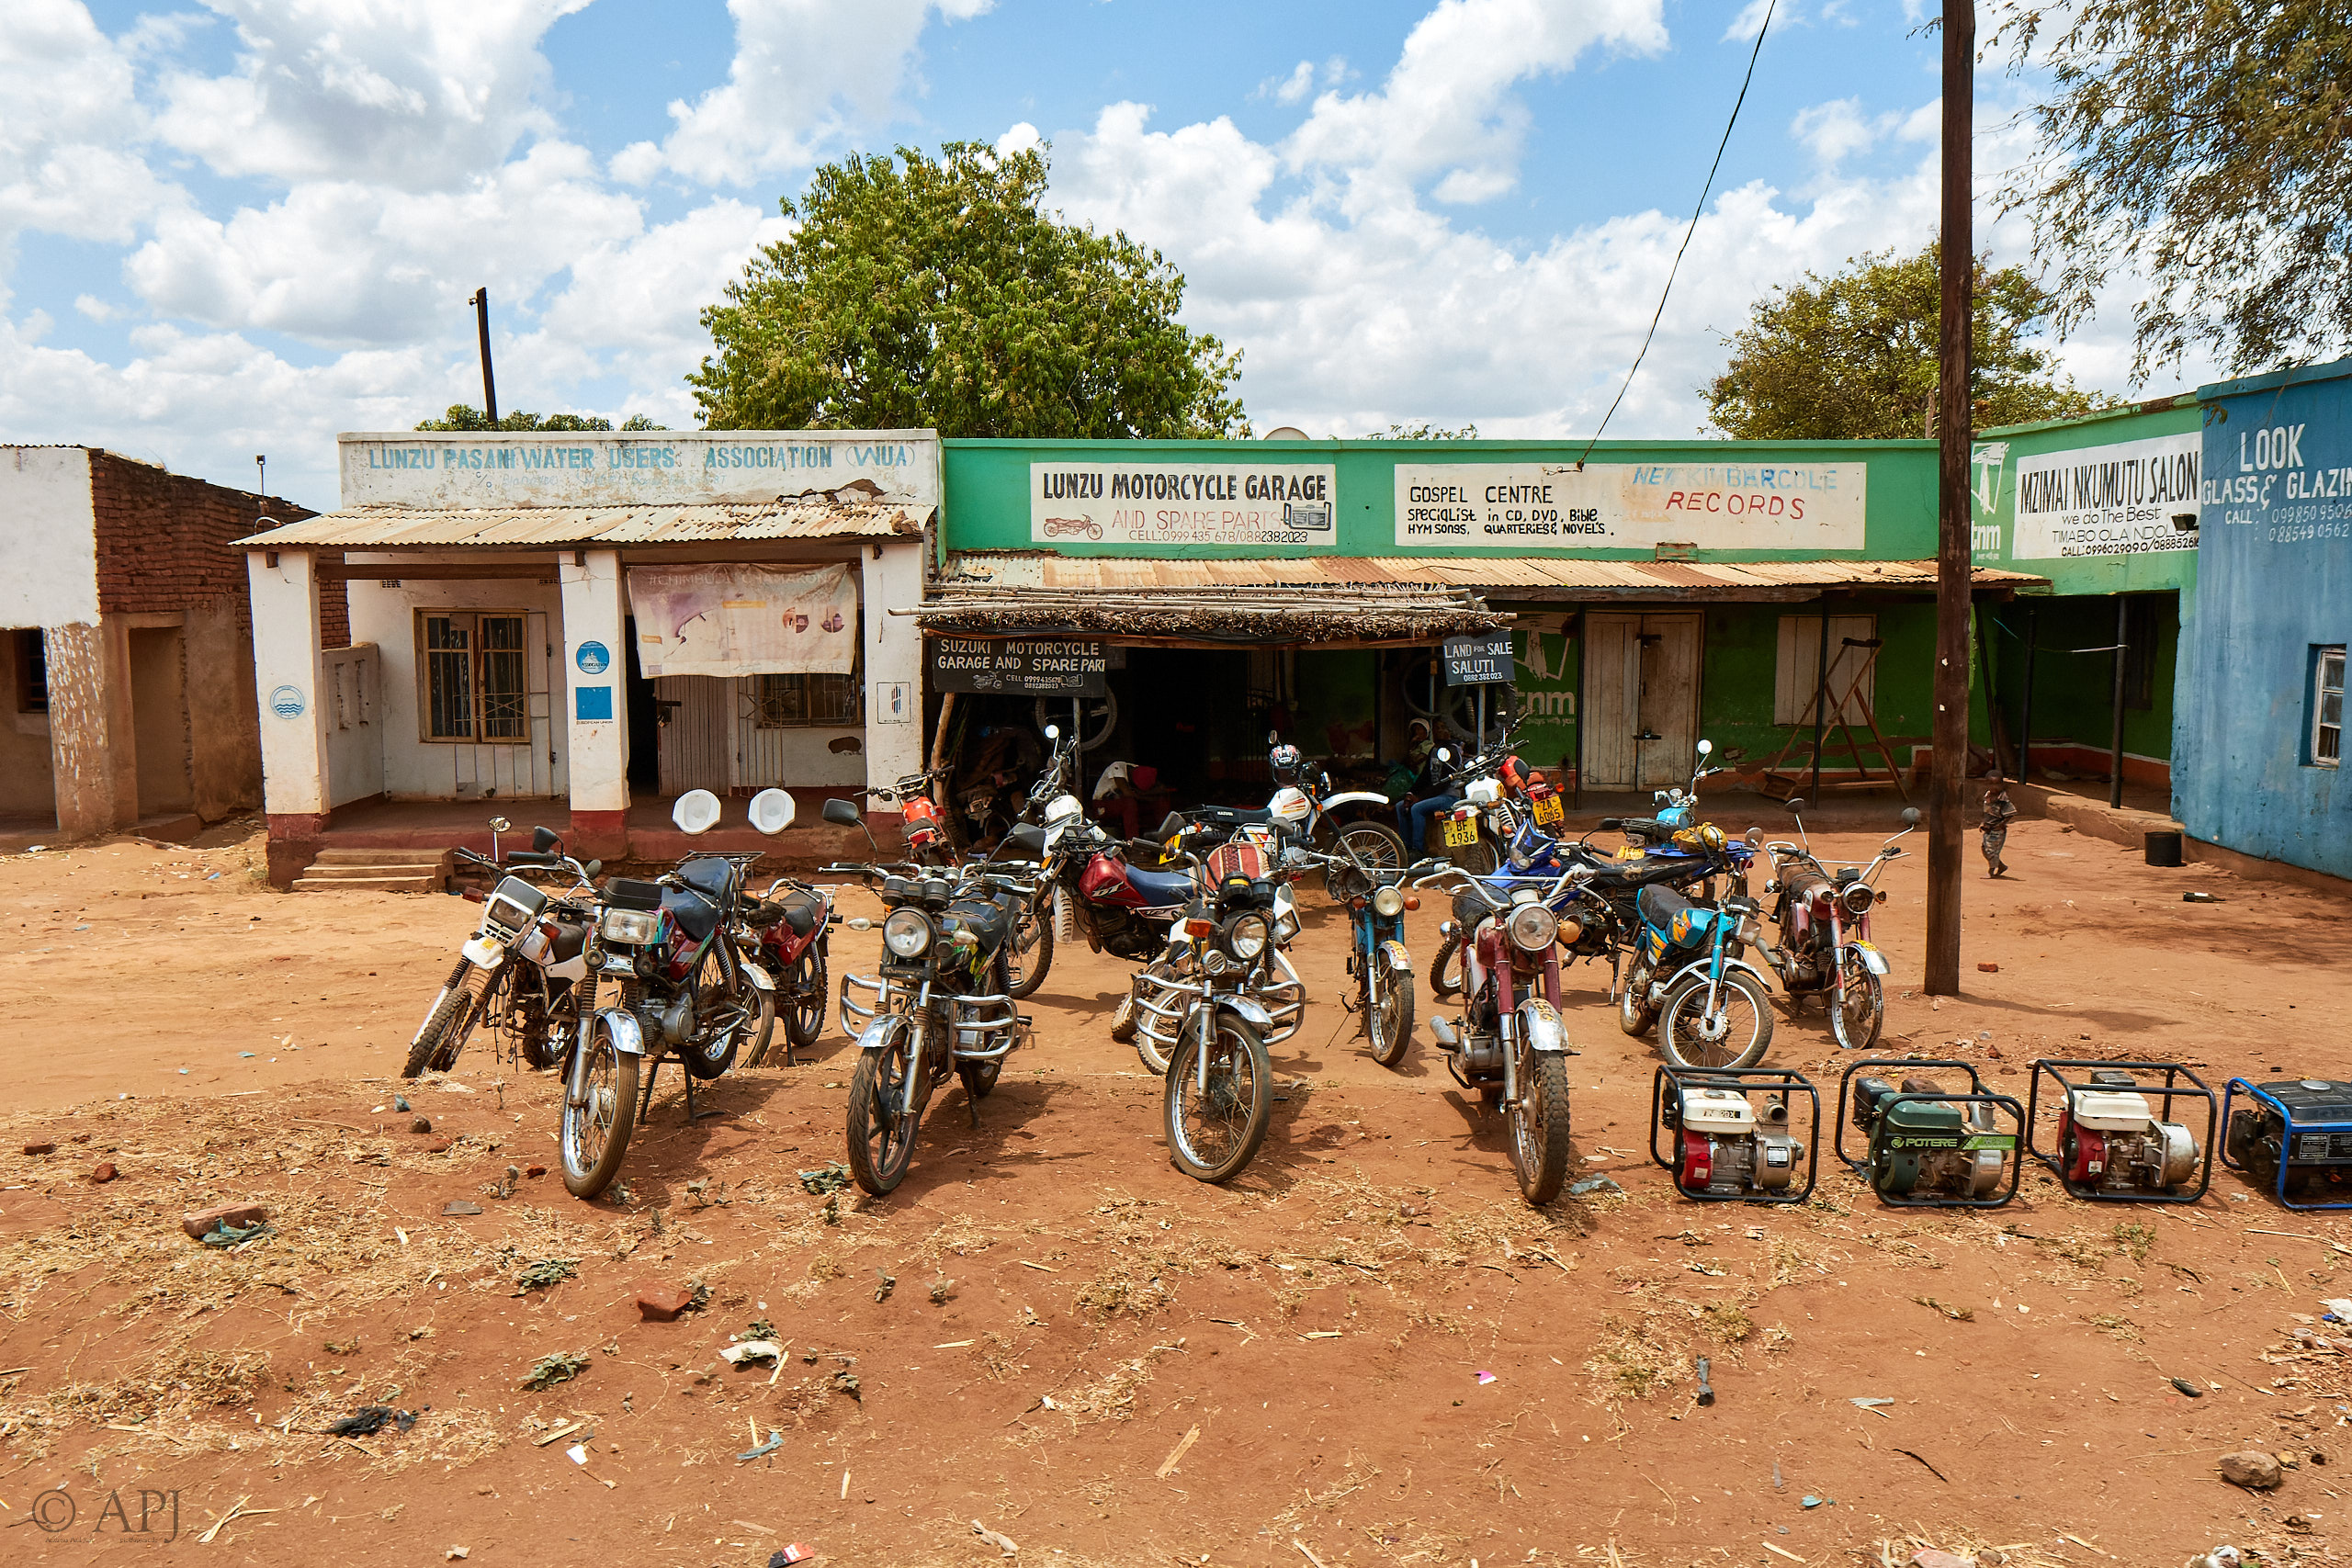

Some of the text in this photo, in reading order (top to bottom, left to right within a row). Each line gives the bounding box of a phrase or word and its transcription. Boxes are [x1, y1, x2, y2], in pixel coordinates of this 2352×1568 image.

[2240, 423, 2305, 472] LOOK
[368, 448, 435, 469] LUNZU
[520, 447, 594, 469] WATER
[609, 447, 675, 468] USERS
[705, 446, 832, 469] ASSOCIATION
[846, 446, 915, 467] (WUA)
[1043, 472, 1327, 501] LUNZU MOTORCYCLE GARAGE
[2020, 451, 2199, 513] MZIMAI NKUMUTU SALON
[2202, 475, 2258, 506] GLASS
[1409, 485, 1554, 503] GOSPEL CENTRE
[1666, 491, 1805, 520] RECORDS
[1112, 510, 1283, 530] AND SPARE PARTS
[1487, 508, 1499, 522] in
[2062, 506, 2162, 525] we do The Best
[1408, 524, 1432, 535] HYM
[2052, 528, 2096, 544] TIMABO
[2098, 526, 2130, 542] OLA
[940, 638, 1100, 656] SUZUKI MOTORCYCLE
[1443, 644, 1473, 659] LAND
[1487, 641, 1513, 656] SALE
[937, 656, 990, 670] GARAGE
[995, 656, 1022, 670] AND
[1032, 658, 1079, 672] SPARE
[1452, 659, 1495, 674] SALUTI
[1451, 831, 1476, 844] 1936
[1905, 1138, 1958, 1147] POTERE
